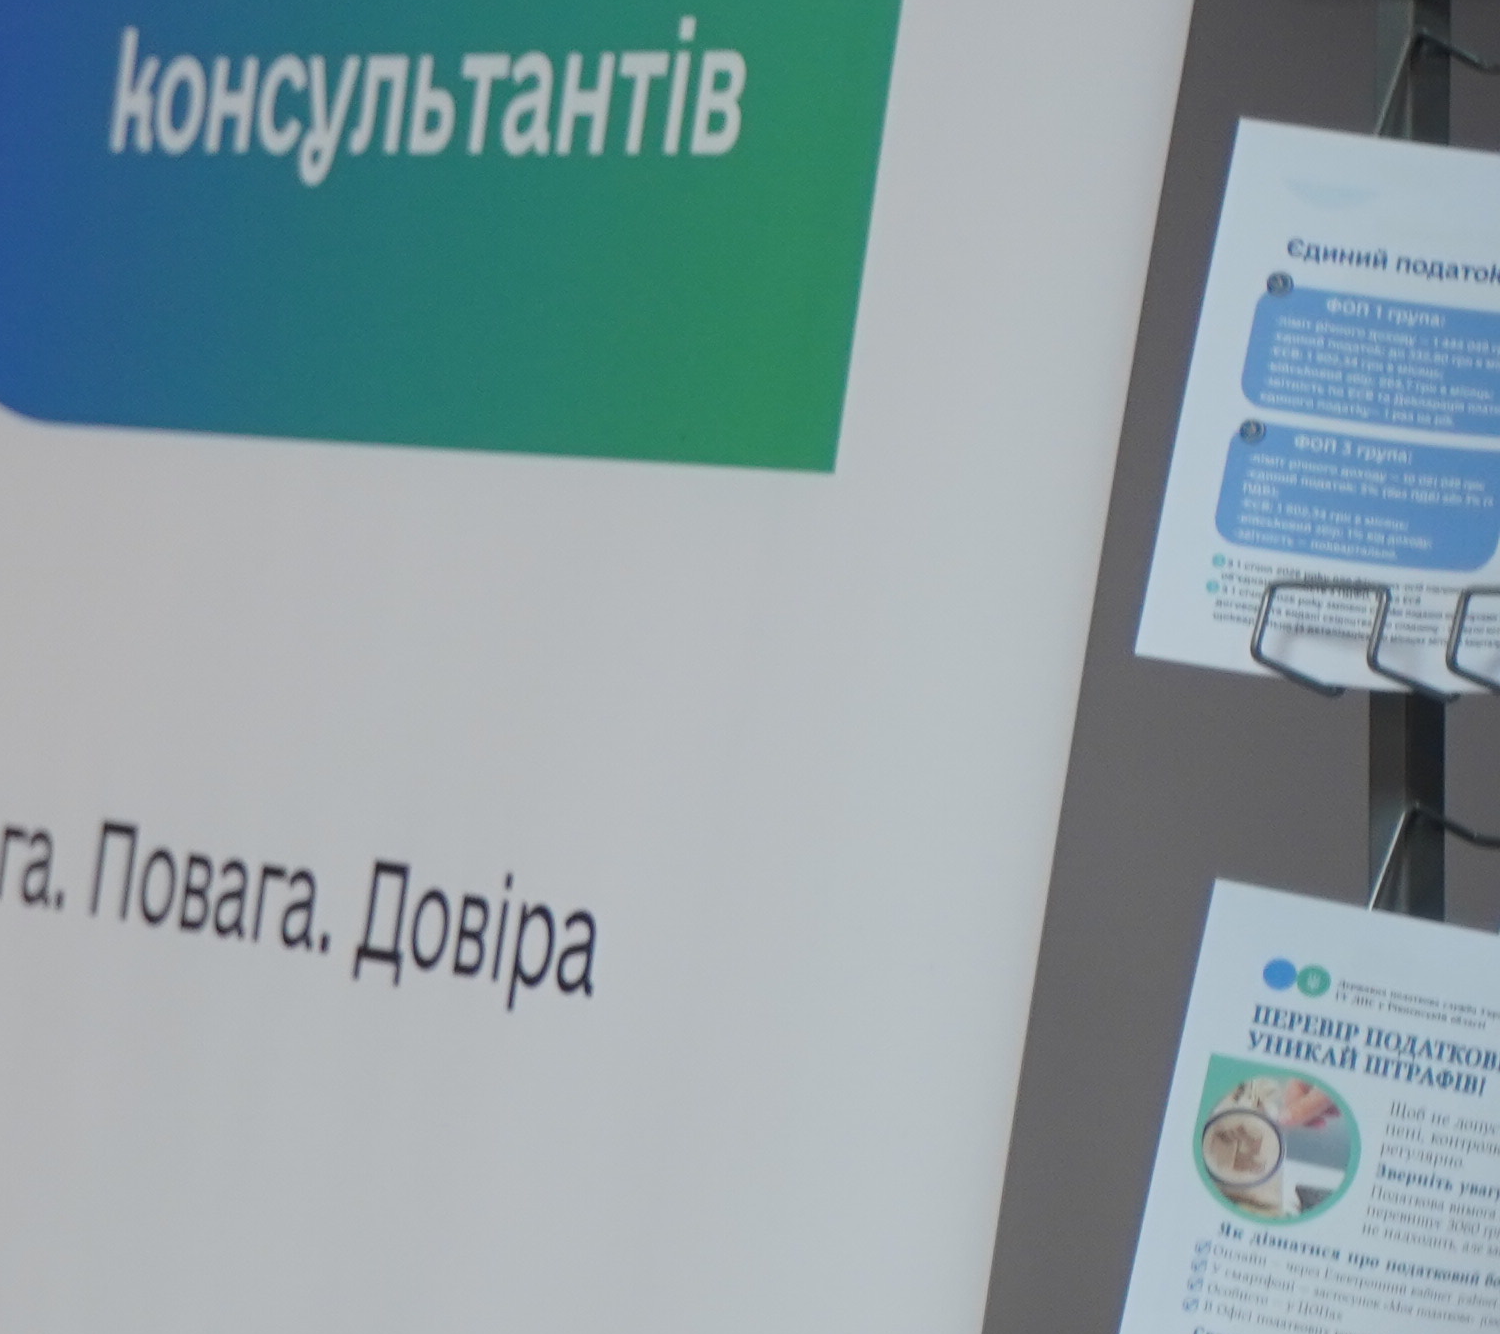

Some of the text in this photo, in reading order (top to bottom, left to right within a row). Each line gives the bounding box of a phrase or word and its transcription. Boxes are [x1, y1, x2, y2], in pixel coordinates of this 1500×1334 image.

[109, 17, 747, 186] консультантів
[1285, 237, 1389, 271] Єдиний
[1324, 297, 1370, 318] ФОП
[1373, 303, 1384, 320] 1
[1292, 433, 1338, 455] ФОП
[1340, 439, 1354, 456] 3
[89, 819, 331, 954] Повага.
[352, 859, 599, 1013] Довіра
[1251, 1003, 1500, 1070] ПЕРЕВІР ПОДАТКОВ
[1246, 1027, 1486, 1098] УНИКАЙ ШТРАФІВ!
[1389, 1101, 1426, 1122] Щоб
[1430, 1111, 1450, 1126] не
[1375, 1162, 1455, 1192] Зверніть
[1371, 1185, 1445, 1211] Податкова
[1361, 1222, 1380, 1236] не
[1218, 1220, 1479, 1290] Як дізнатися про податковий
